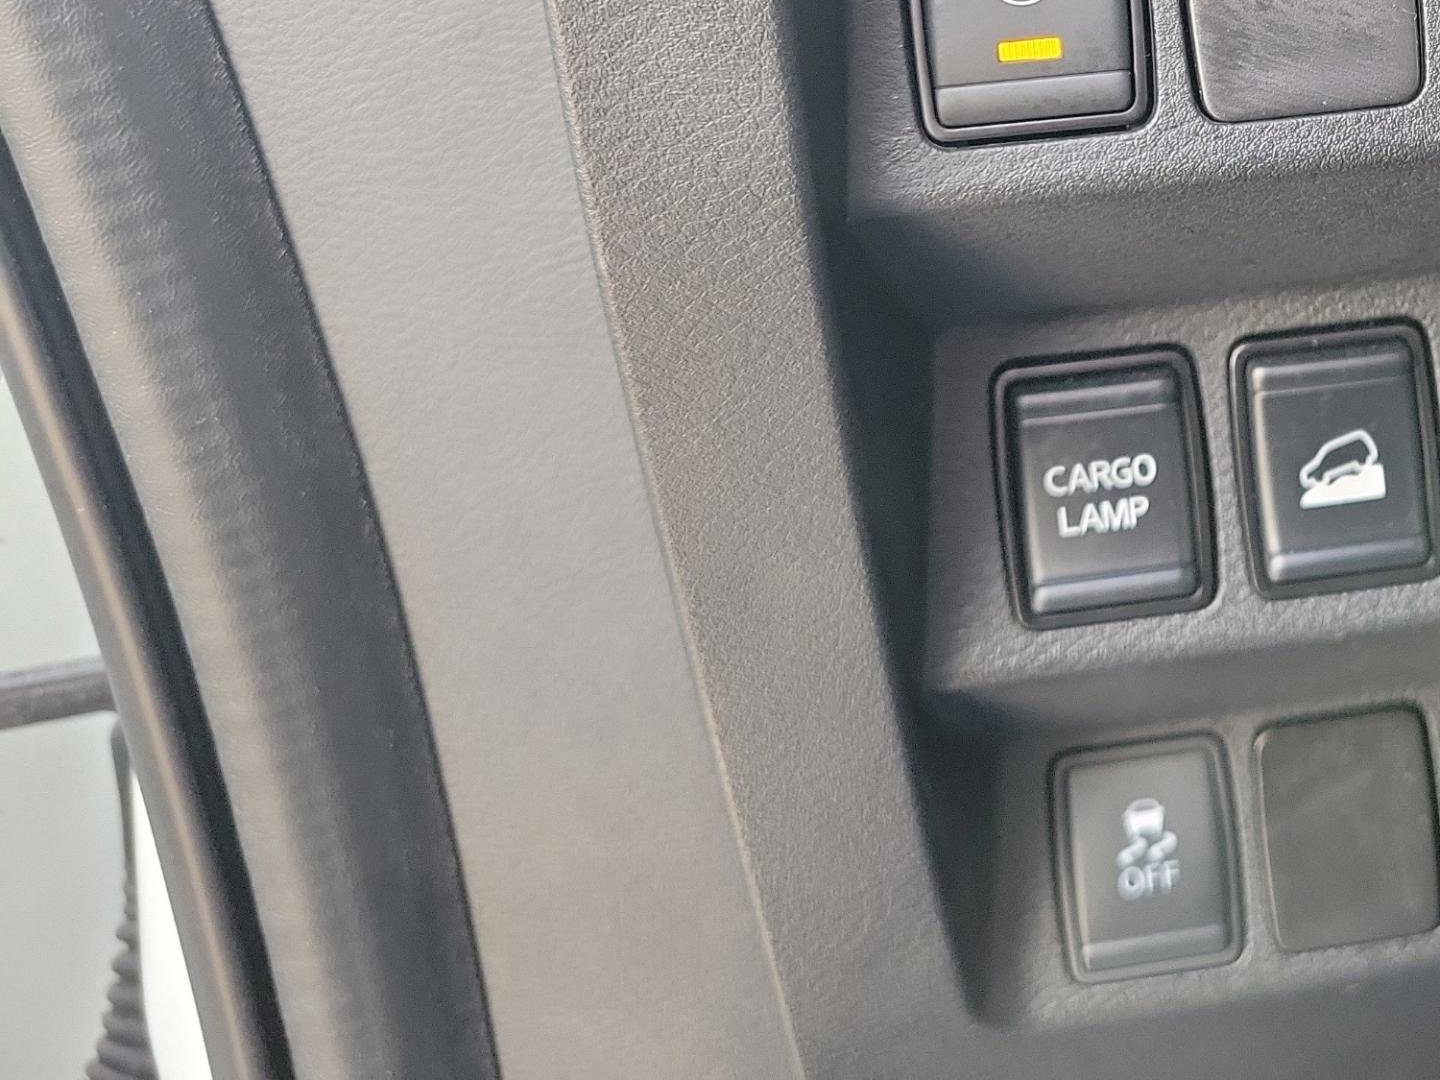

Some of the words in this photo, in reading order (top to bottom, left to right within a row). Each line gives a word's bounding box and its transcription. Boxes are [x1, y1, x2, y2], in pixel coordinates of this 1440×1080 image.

[1043, 453, 1157, 498] CARGO
[1056, 495, 1150, 539] LAMP
[1118, 859, 1180, 900] OFF
